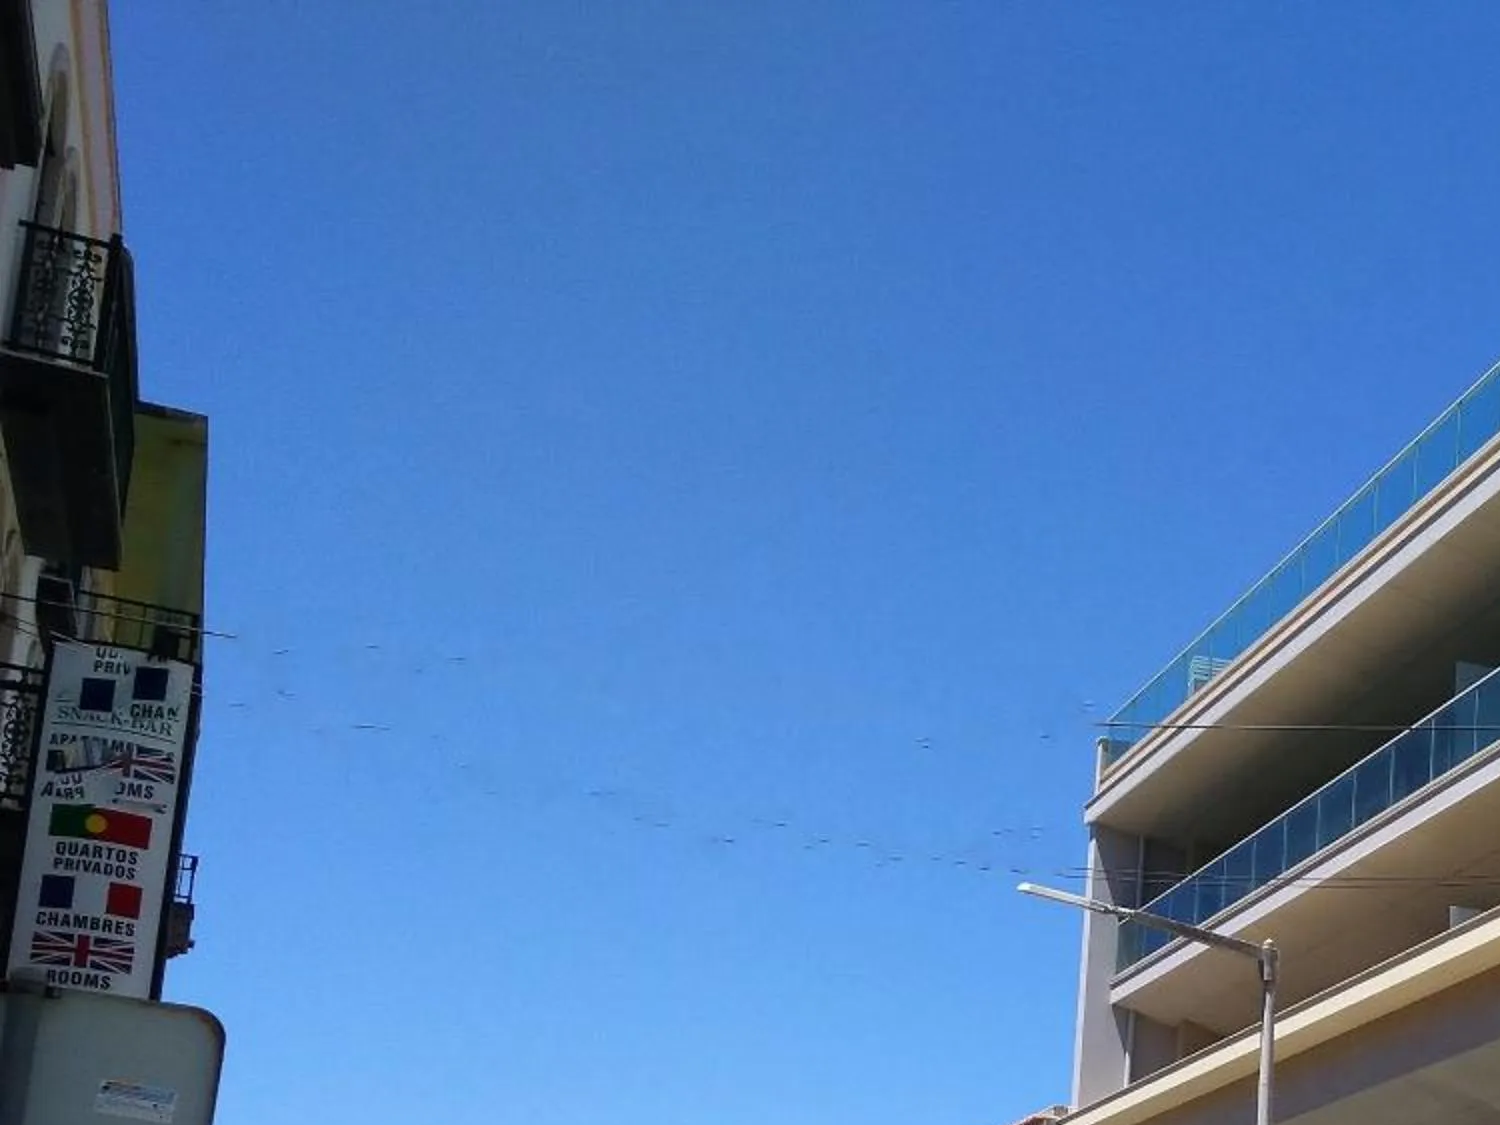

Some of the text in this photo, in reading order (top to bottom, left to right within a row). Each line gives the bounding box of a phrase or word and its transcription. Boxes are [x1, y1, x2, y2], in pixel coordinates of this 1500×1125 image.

[55, 841, 140, 865] QUARTOS
[52, 858, 137, 880] PRIVADOS
[36, 911, 136, 937] CHAMBRES
[47, 969, 112, 990] ROOMS
